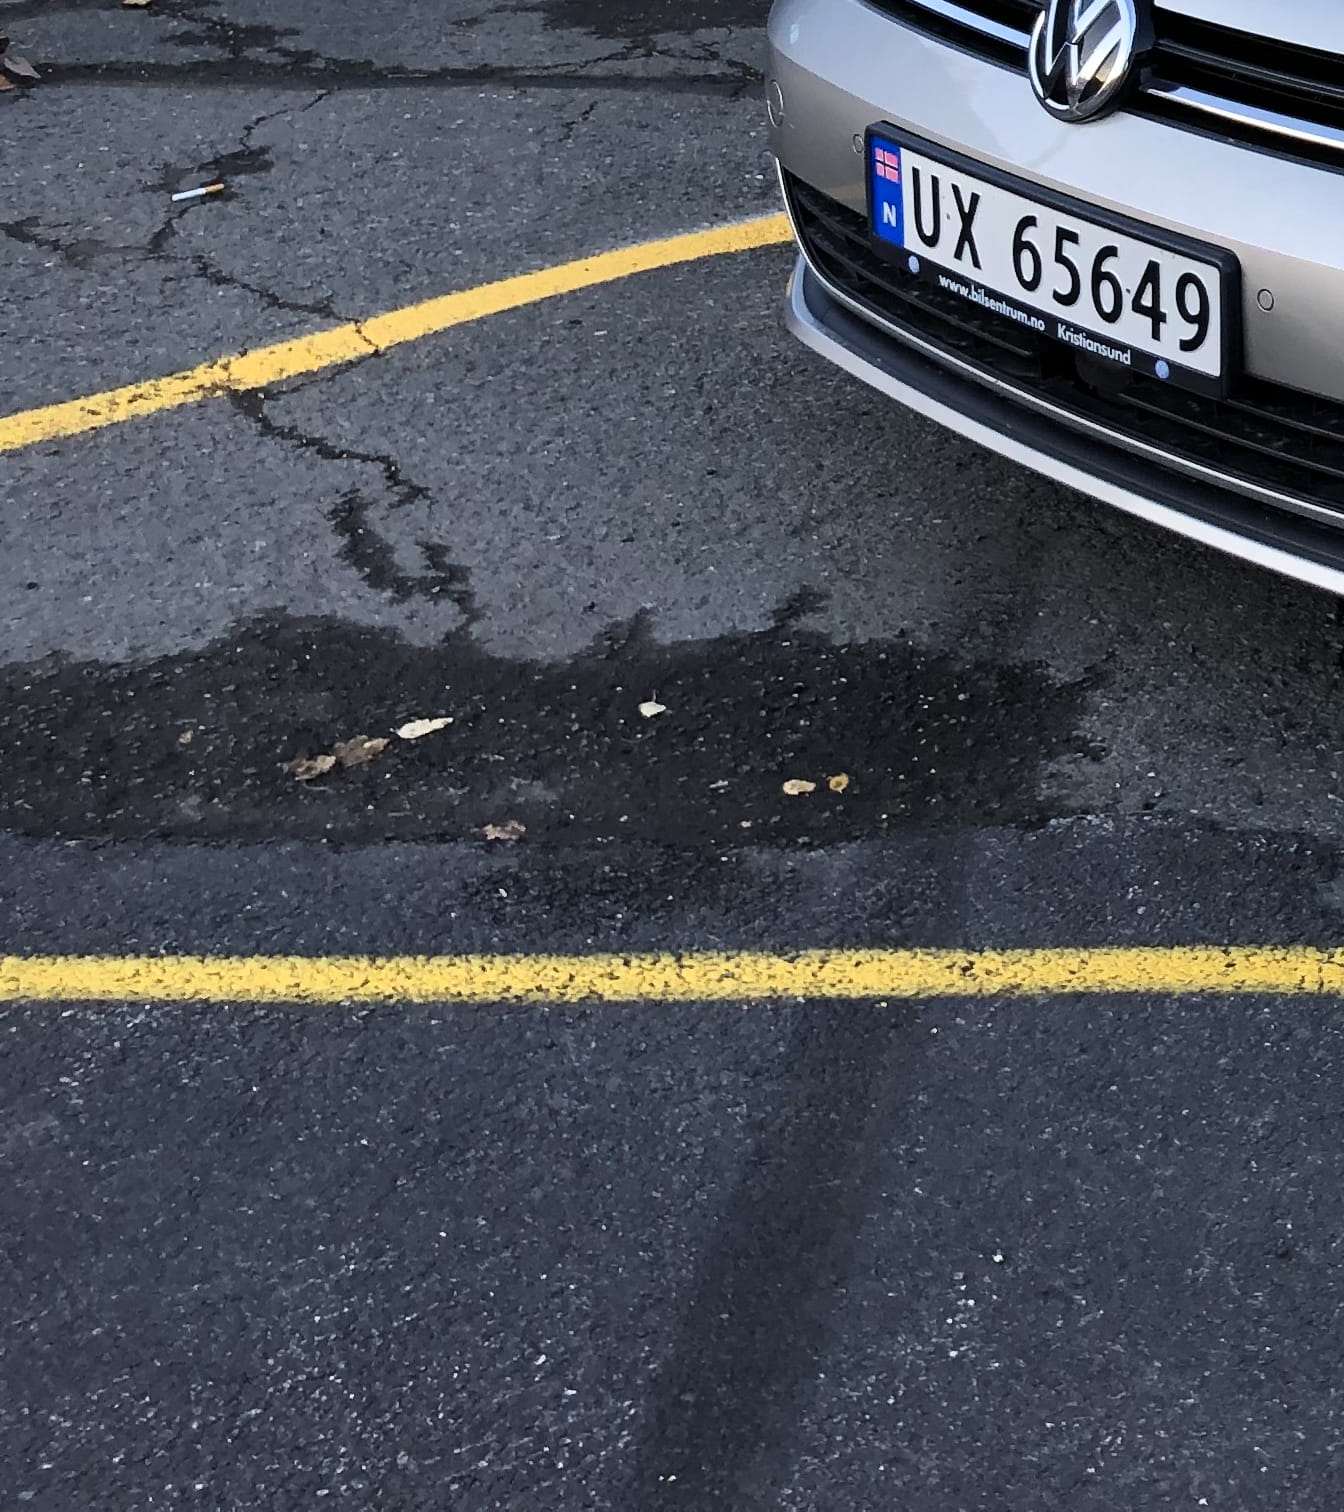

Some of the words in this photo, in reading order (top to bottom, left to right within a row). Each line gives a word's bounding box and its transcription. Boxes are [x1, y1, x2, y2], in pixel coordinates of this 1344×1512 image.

[882, 201, 897, 228] N
[911, 165, 983, 271] UX
[1012, 214, 1211, 353] 65649
[938, 273, 1046, 332] www.bilsentrum.no
[1056, 322, 1132, 366] Kristiansund
